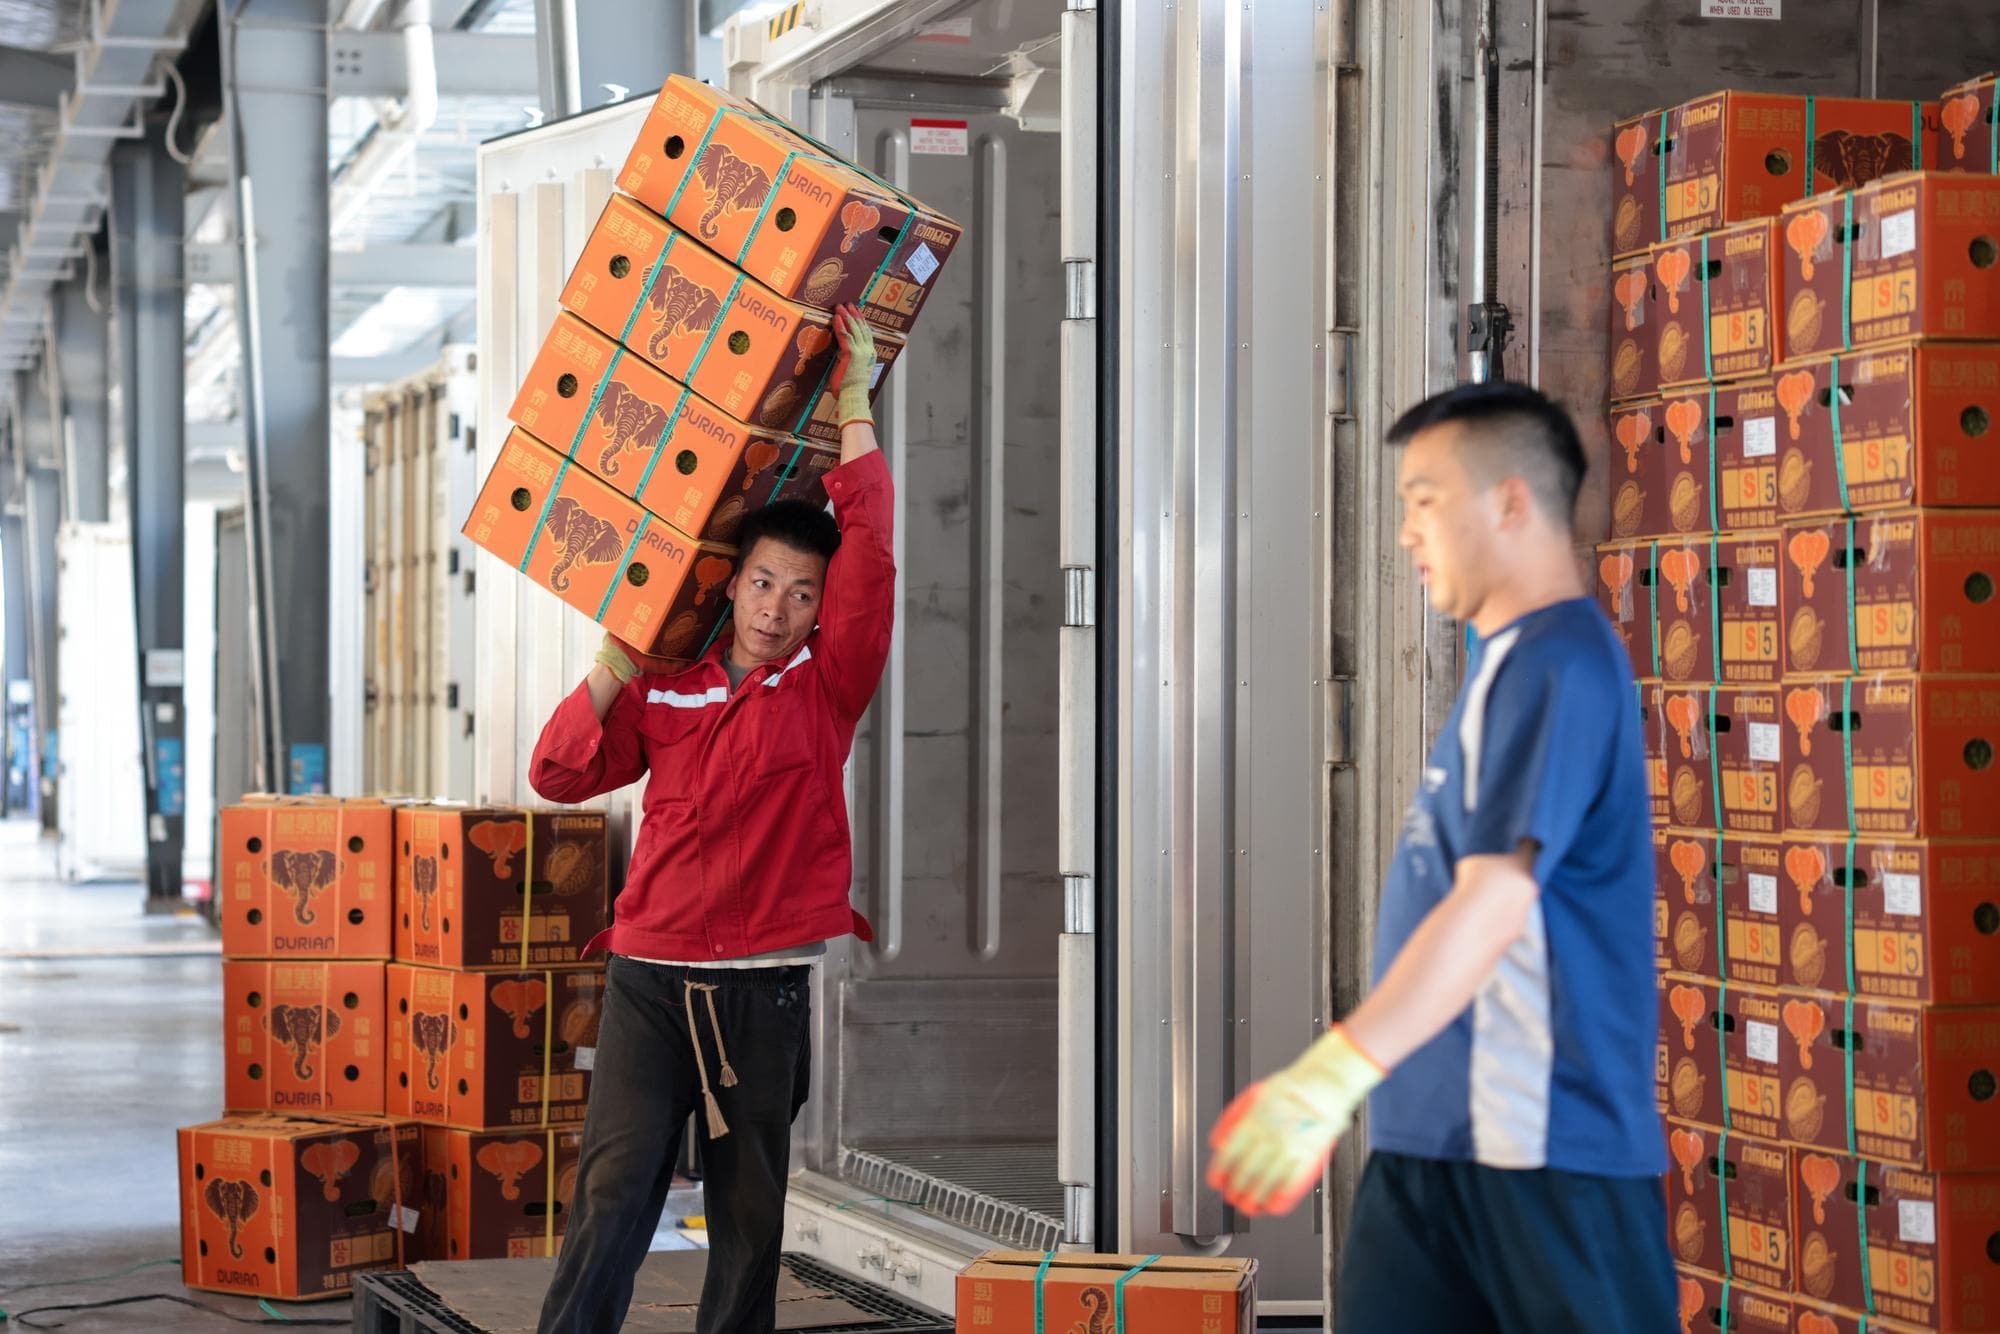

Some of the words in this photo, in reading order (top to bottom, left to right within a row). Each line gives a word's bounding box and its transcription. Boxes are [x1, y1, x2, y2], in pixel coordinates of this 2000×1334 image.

[1709, 5, 1724, 15] WHEN
[1728, 6, 1740, 16] USED
[1744, 7, 1751, 16] AS
[1754, 7, 1773, 17] REEFER
[776, 164, 833, 208] URIAN
[1687, 183, 1696, 208] S
[885, 282, 901, 302] S
[905, 287, 922, 308] 4
[1879, 280, 1890, 307] S
[1731, 315, 1742, 342] S
[1749, 316, 1757, 345] 5
[1867, 442, 1879, 470] S
[1743, 473, 1756, 499] S
[1765, 474, 1775, 502] 5
[1875, 608, 1888, 636] S
[1745, 626, 1756, 653] S
[1763, 626, 1772, 655] 5
[1743, 776, 1756, 802] S
[1763, 776, 1772, 805] 5
[1873, 770, 1886, 798] S
[274, 937, 335, 950] DURIAN
[1749, 927, 1760, 953] S
[1883, 937, 1896, 965] S
[274, 1091, 333, 1108] DURIAN
[1747, 1079, 1760, 1105] S
[1877, 1096, 1889, 1124] S
[1750, 1226, 1762, 1252] S
[1768, 1231, 1780, 1263] 5
[217, 1269, 259, 1288] DURIAN
[1895, 1258, 1908, 1288] S
